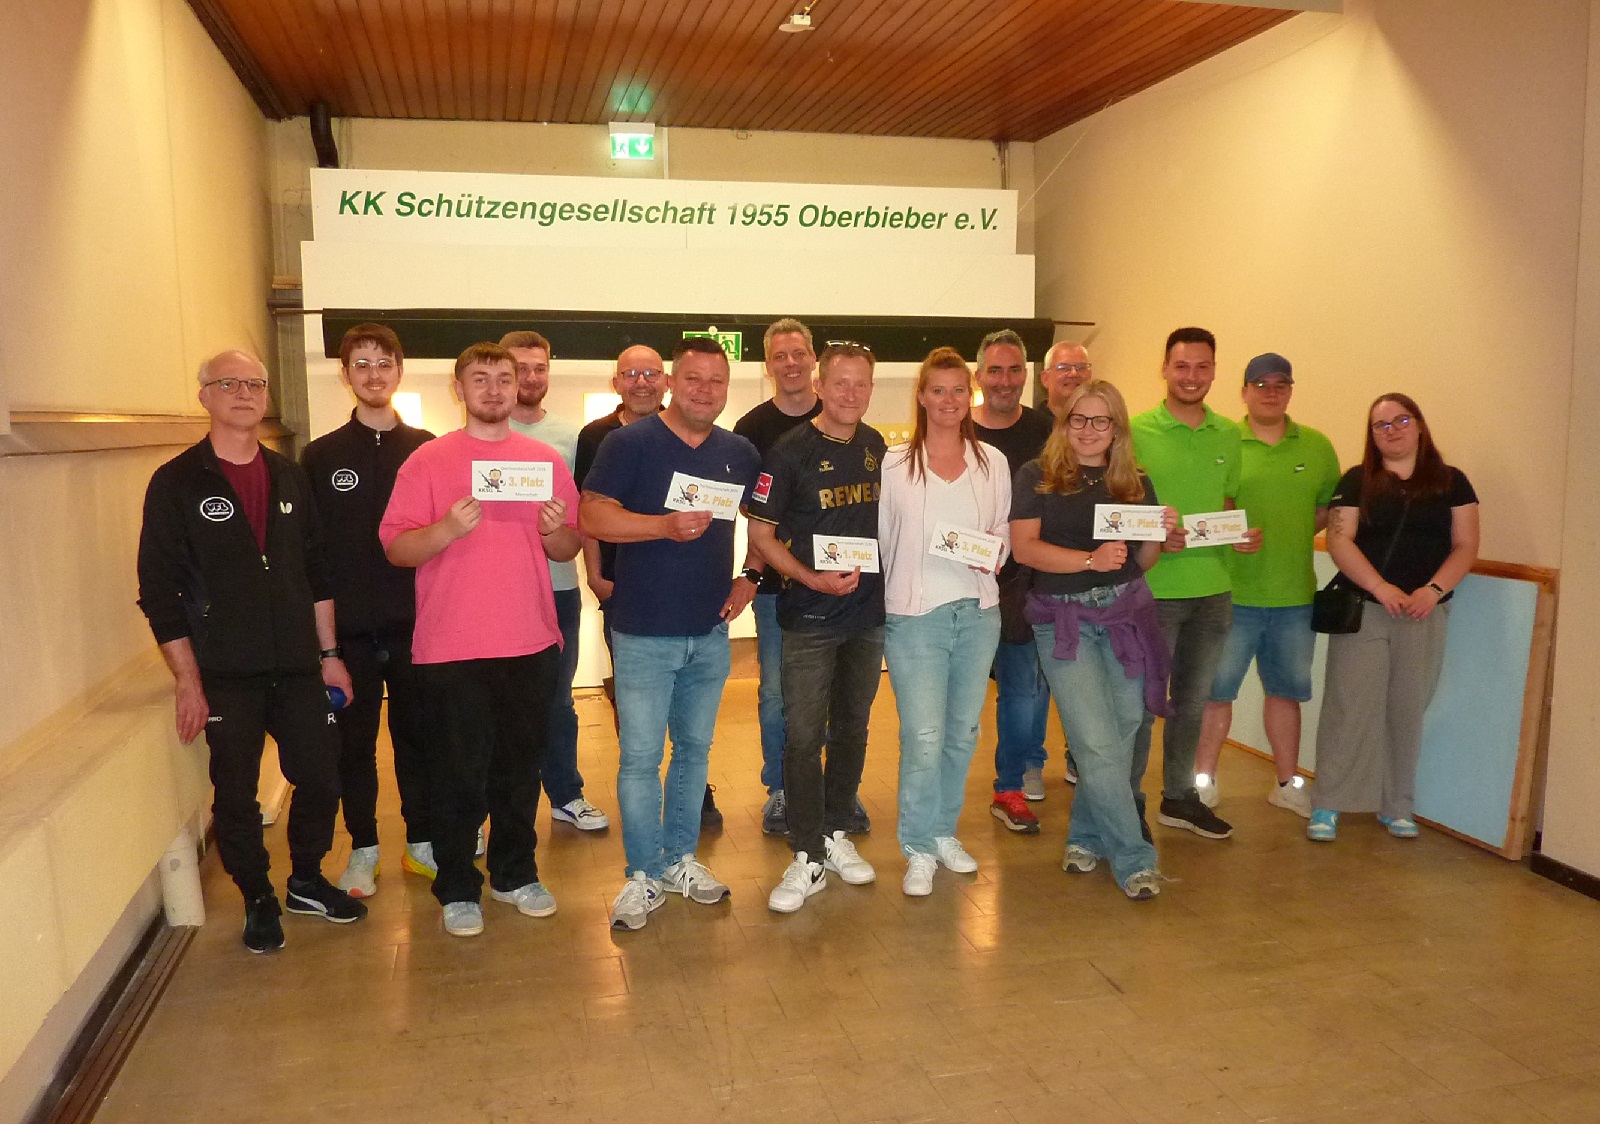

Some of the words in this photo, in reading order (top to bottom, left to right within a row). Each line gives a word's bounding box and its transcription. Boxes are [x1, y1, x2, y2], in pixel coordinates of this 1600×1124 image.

[338, 190, 386, 216] KK
[395, 191, 716, 227] Schützengesellschaft
[727, 203, 790, 227] 1955
[798, 204, 948, 230] Oberbieber
[508, 476, 518, 487] 3.
[520, 476, 545, 487] Platz
[702, 494, 711, 505] 2.
[712, 495, 735, 509] Platz
[818, 483, 873, 510] REWE
[1126, 518, 1136, 529] 1.
[1136, 518, 1159, 529] Platz
[842, 549, 851, 559] 1.
[852, 550, 873, 561] Platz
[962, 541, 969, 552] 3.
[971, 543, 993, 559] Platz
